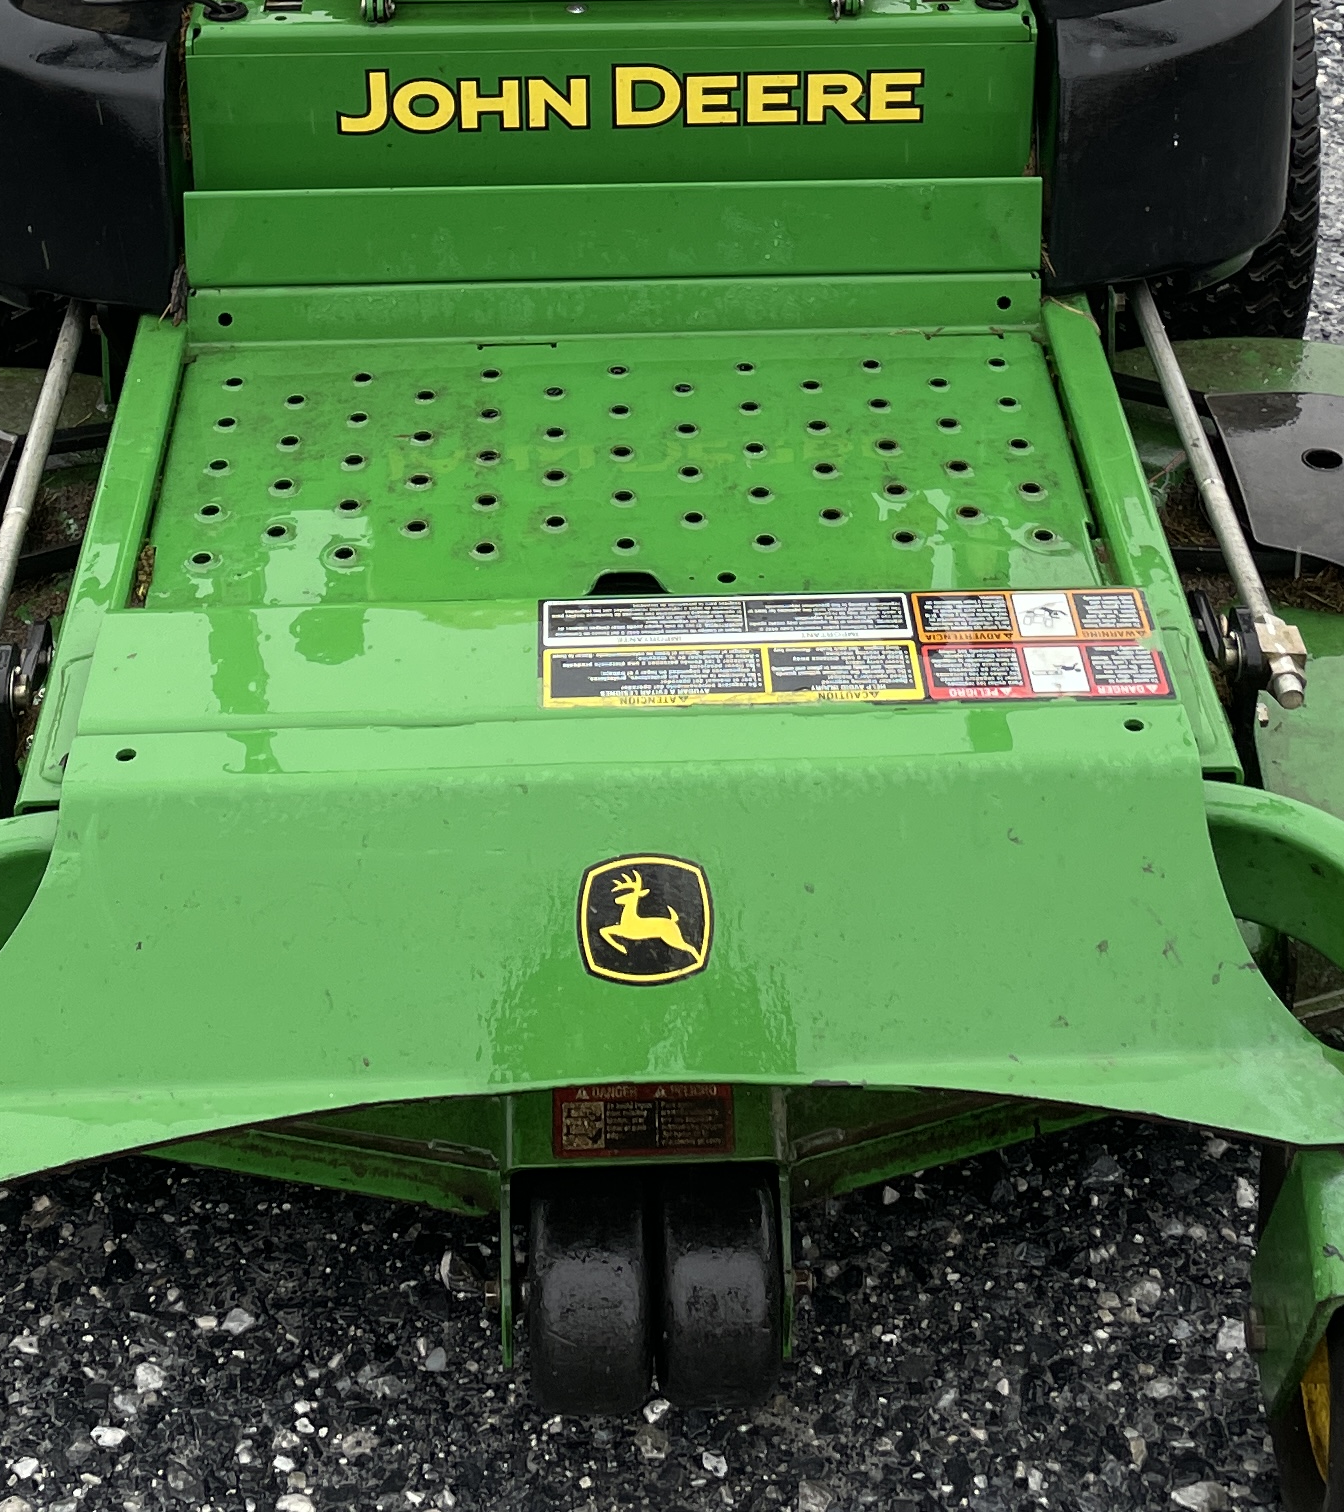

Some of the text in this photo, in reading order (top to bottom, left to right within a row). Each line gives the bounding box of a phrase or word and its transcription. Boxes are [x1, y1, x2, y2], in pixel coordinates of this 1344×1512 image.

[337, 64, 926, 136] JOHN DEERE
[801, 631, 859, 639] IMPORTANT
[925, 632, 1001, 641] ADVERTENCIA
[1083, 630, 1136, 638] WARNING
[617, 635, 682, 643] IMPORTANTE
[949, 687, 999, 697] PELIGRO
[1097, 685, 1145, 694] DANGER
[817, 691, 868, 700] CAUTION
[619, 695, 679, 706] ATENCION
